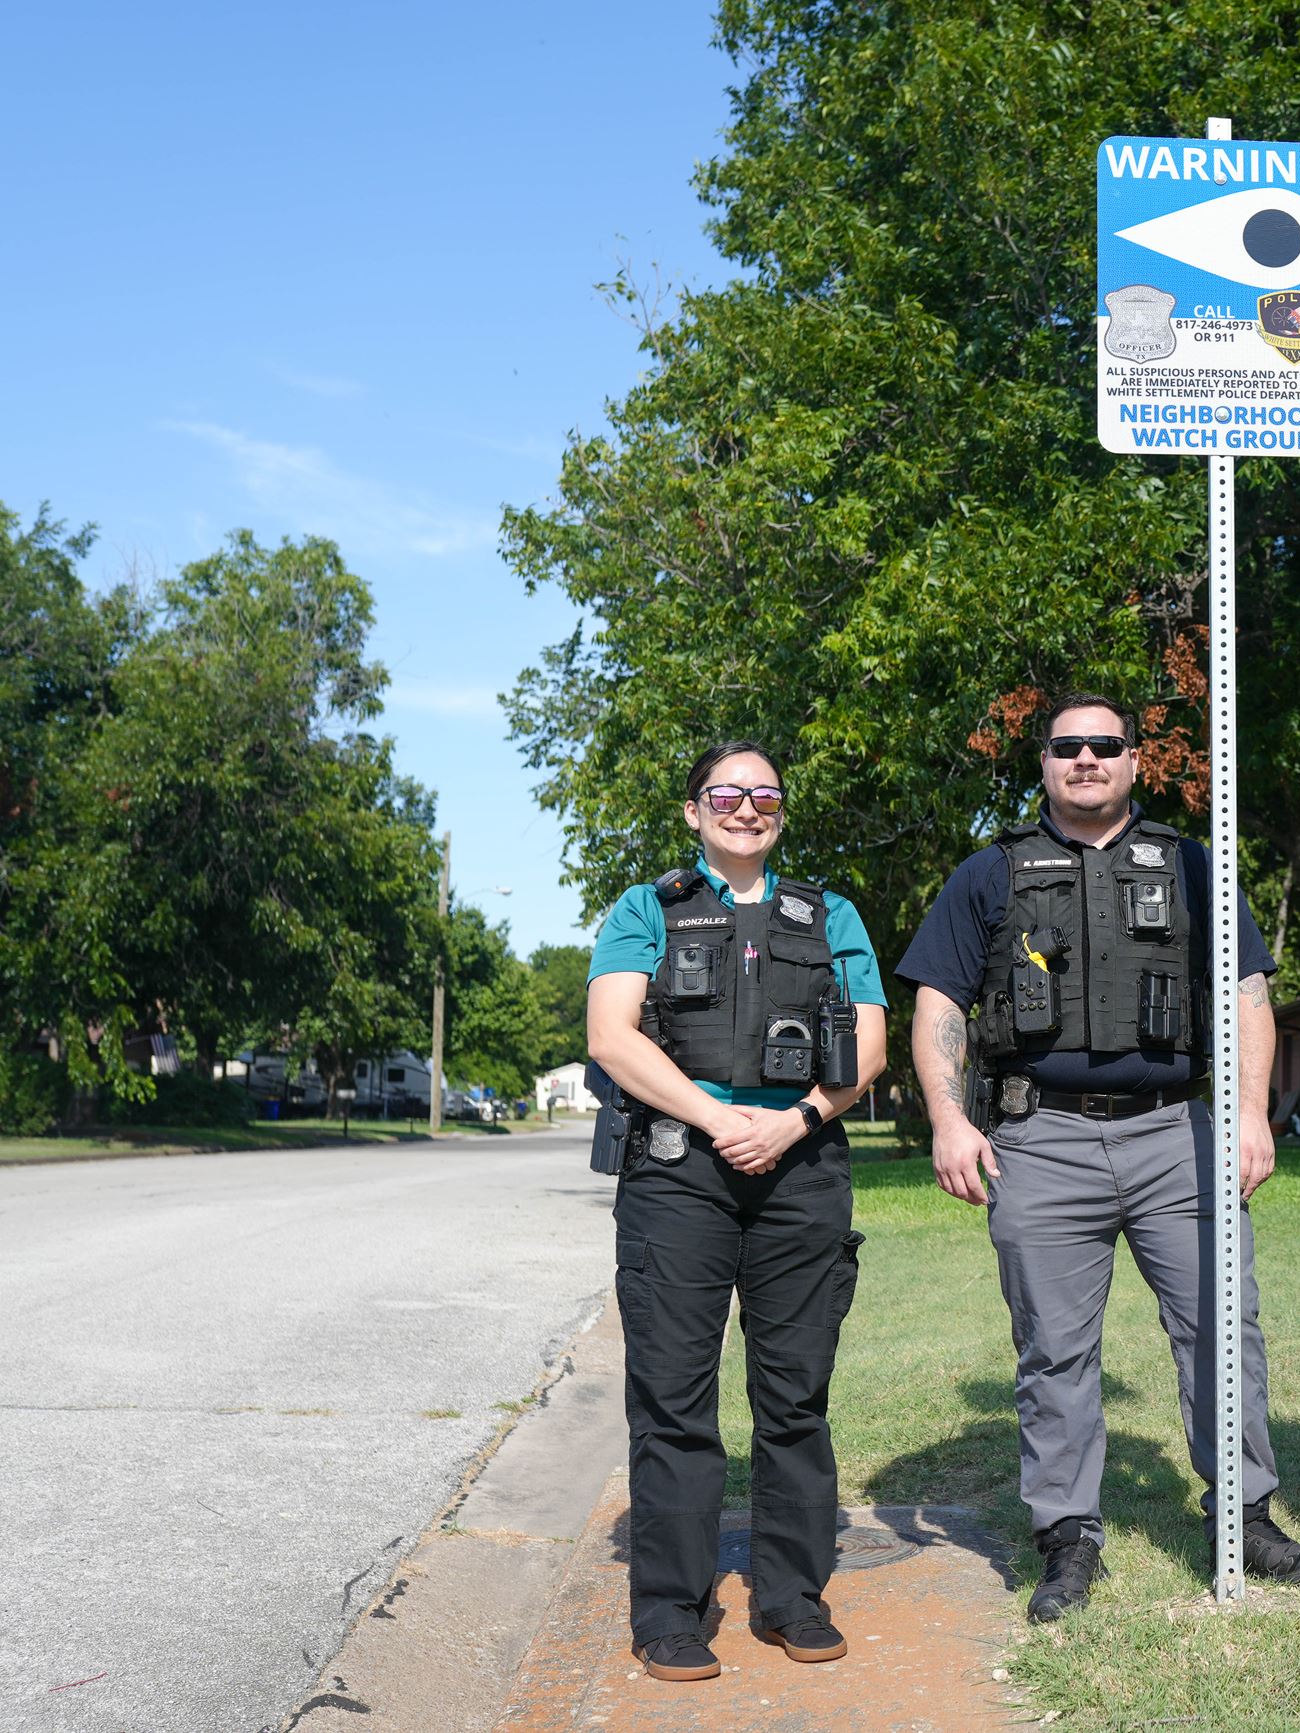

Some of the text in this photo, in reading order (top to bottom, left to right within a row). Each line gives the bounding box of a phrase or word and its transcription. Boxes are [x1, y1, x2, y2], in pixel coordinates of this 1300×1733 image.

[1194, 305, 1235, 318] CALL
[1176, 320, 1253, 331] 817-246-4973
[1194, 332, 1234, 342] OR 911
[1264, 334, 1284, 345] WHITE
[1119, 343, 1162, 352] OFFICER
[1106, 367, 1127, 376] ALL
[1129, 367, 1195, 378] SUSPICIOUS
[1198, 368, 1248, 379] PERSONS
[1250, 370, 1276, 379] AND
[1120, 377, 1142, 387] ARE
[1145, 378, 1220, 388] IMMEDIATELY
[1223, 379, 1280, 389] REPORTED
[1282, 380, 1298, 390] TO
[1106, 387, 1142, 396] WHITE
[1145, 387, 1215, 398] SETTLEMENT
[1218, 389, 1257, 399] POLICE
[1132, 428, 1217, 448] WATCH
[677, 917, 728, 927] GONZALEZ
